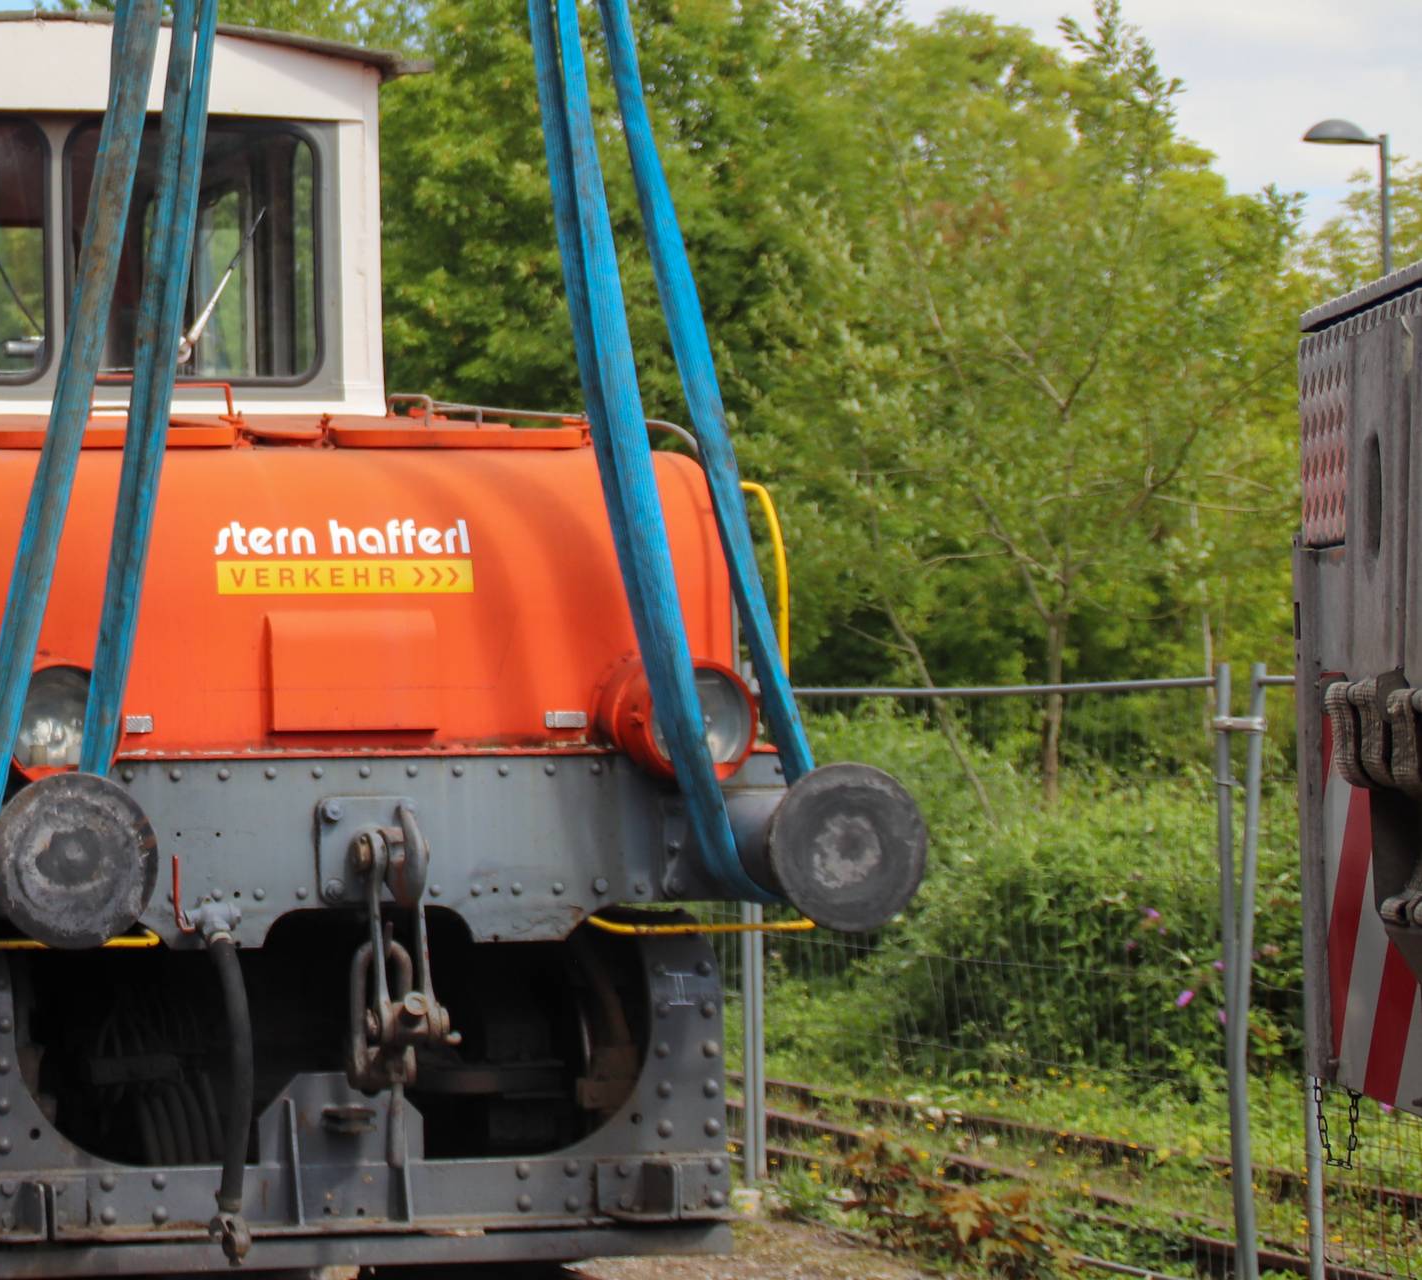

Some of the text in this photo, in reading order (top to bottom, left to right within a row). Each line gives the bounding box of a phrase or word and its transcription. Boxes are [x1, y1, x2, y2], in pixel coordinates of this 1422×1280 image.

[214, 518, 471, 555] stern hafferl
[230, 566, 396, 588] VERKEHR
